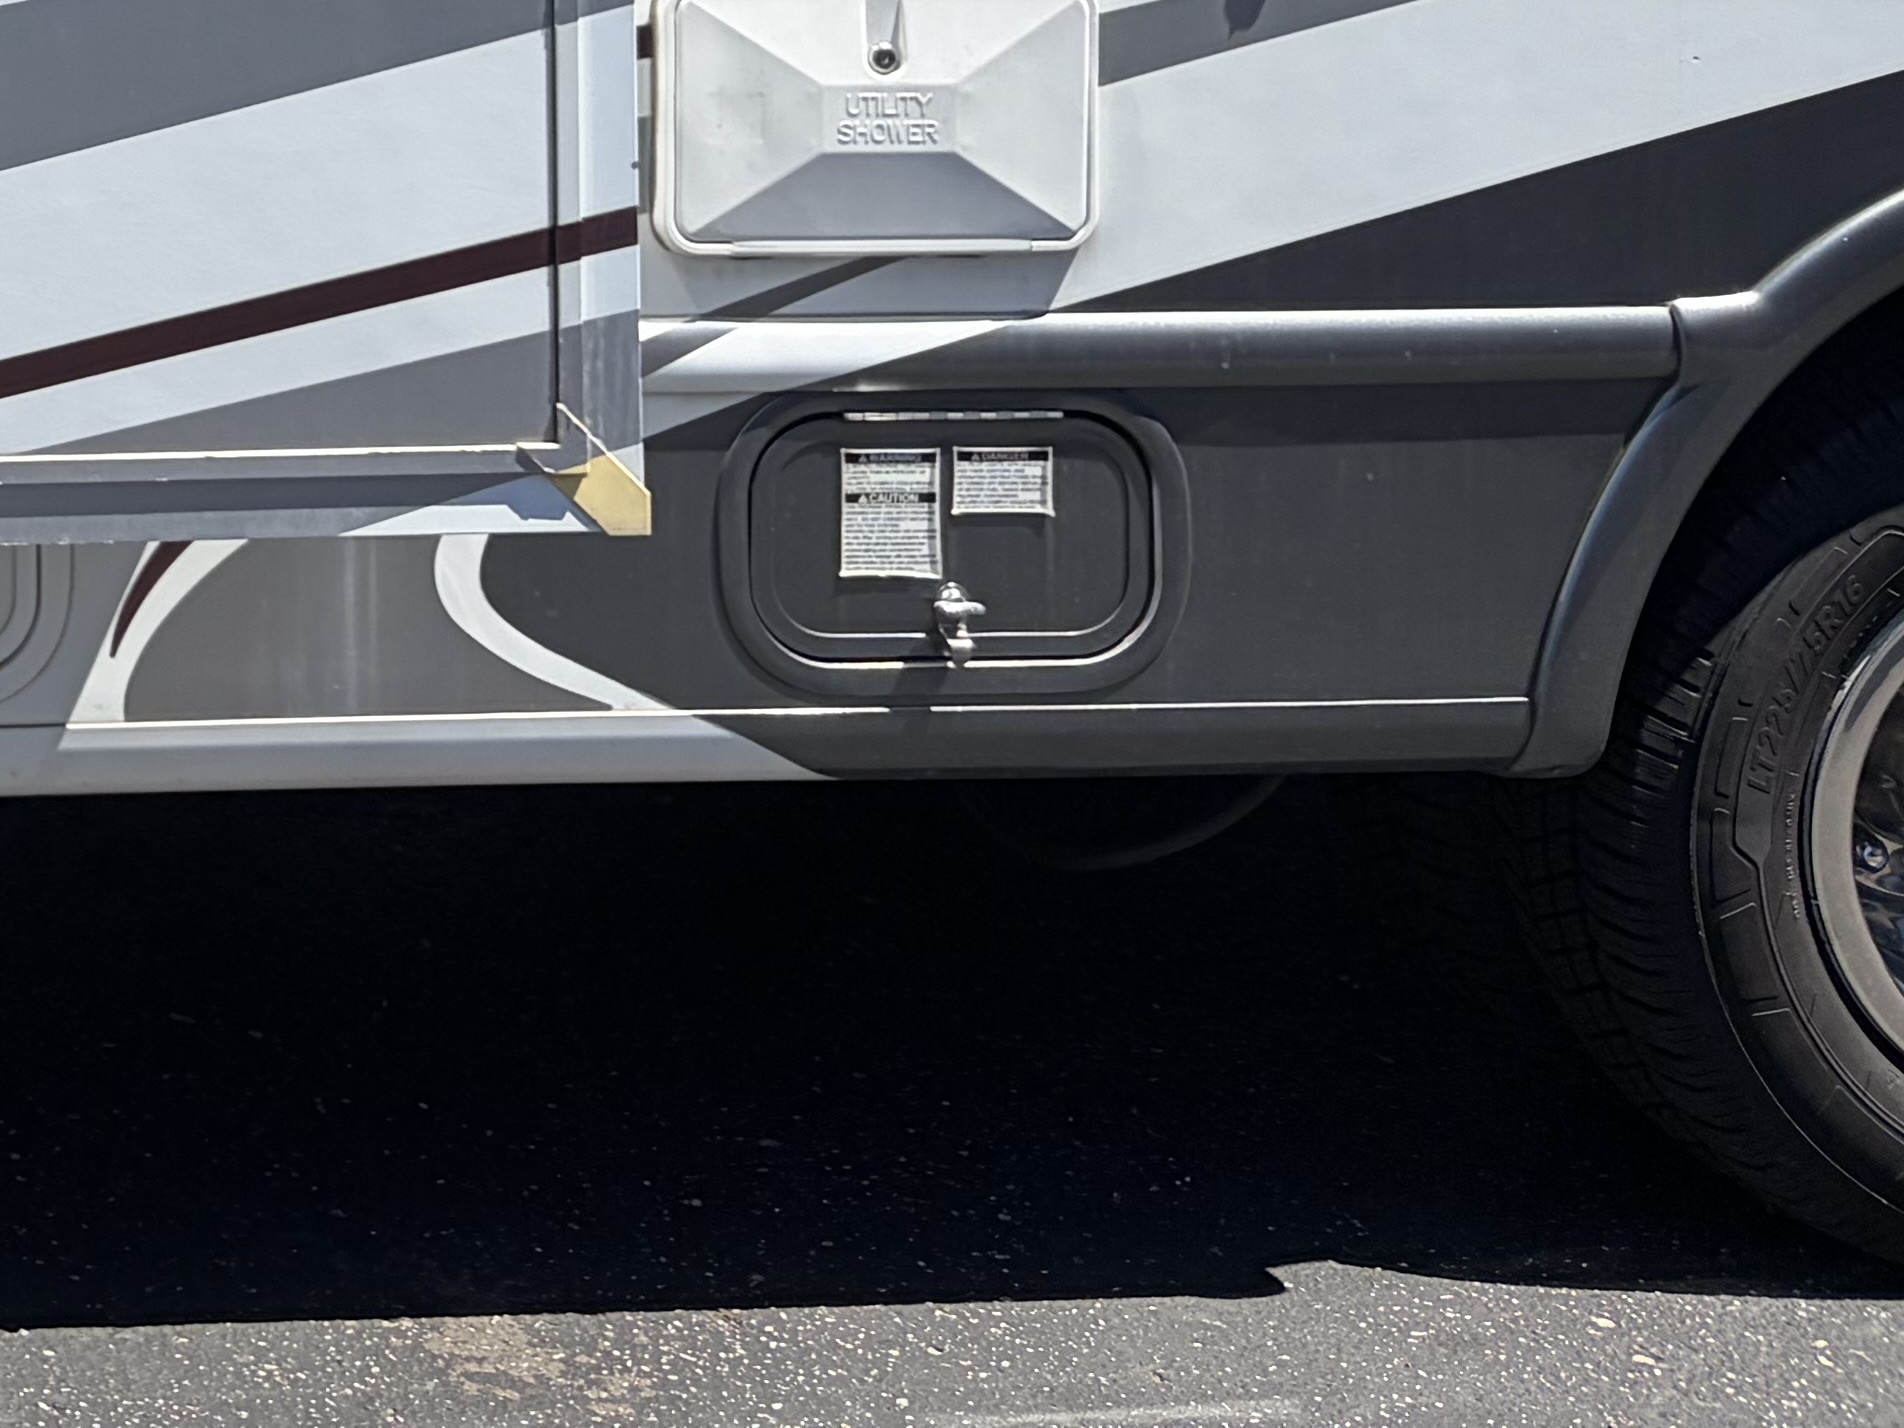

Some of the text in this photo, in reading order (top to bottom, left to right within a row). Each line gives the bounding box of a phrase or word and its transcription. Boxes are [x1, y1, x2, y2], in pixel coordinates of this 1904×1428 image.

[845, 91, 934, 118] UTILITY
[836, 118, 939, 145] SHOWER
[869, 493, 920, 504] CAUTION
[1746, 573, 1865, 795] LT225/75R16
